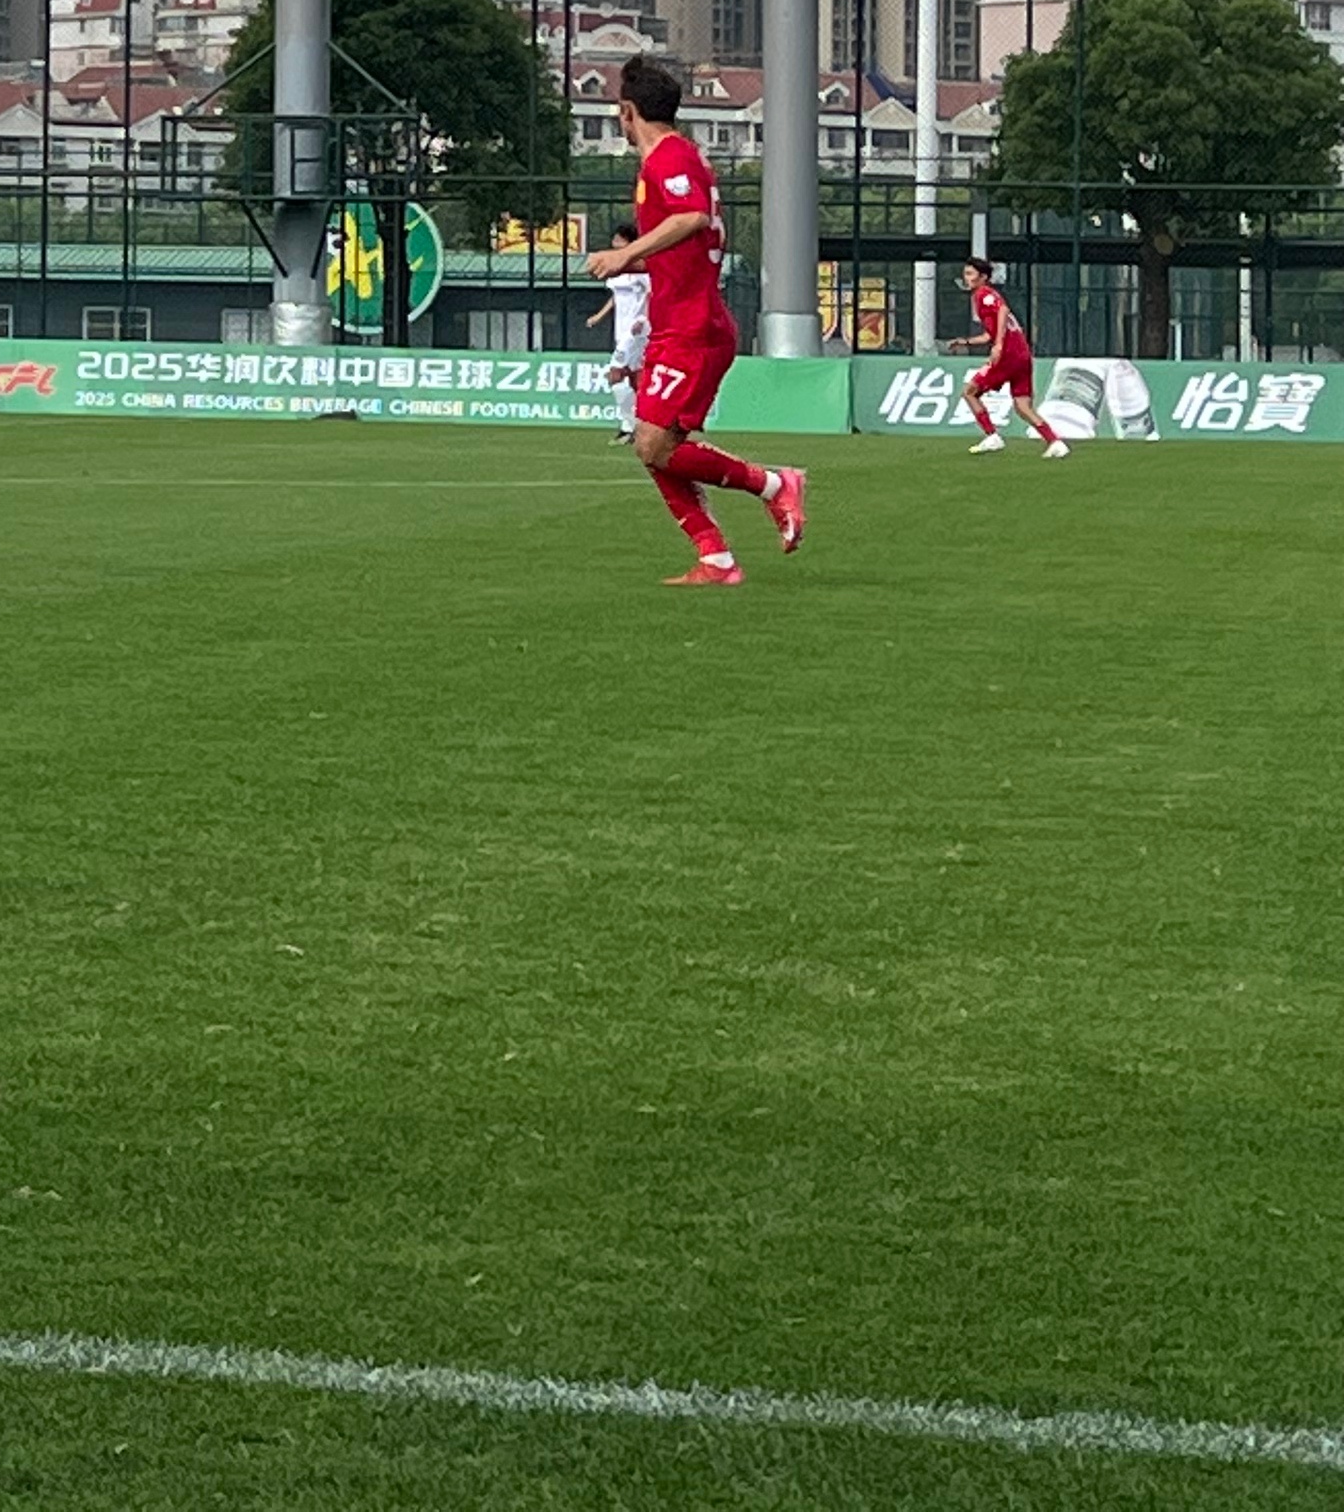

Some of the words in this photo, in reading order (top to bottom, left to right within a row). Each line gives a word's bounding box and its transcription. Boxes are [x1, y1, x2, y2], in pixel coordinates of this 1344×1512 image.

[76, 351, 615, 393] 2025华润饮料中国足球乙级联
[646, 363, 686, 400] 57
[75, 390, 115, 407] 2025
[121, 392, 177, 409] CHINA
[182, 393, 284, 413] RESOURCES
[289, 397, 383, 415] BEVERAGE
[389, 400, 465, 417] CHINESE
[470, 402, 562, 420] FOOTBALL
[1171, 370, 1326, 433] 怡寶
